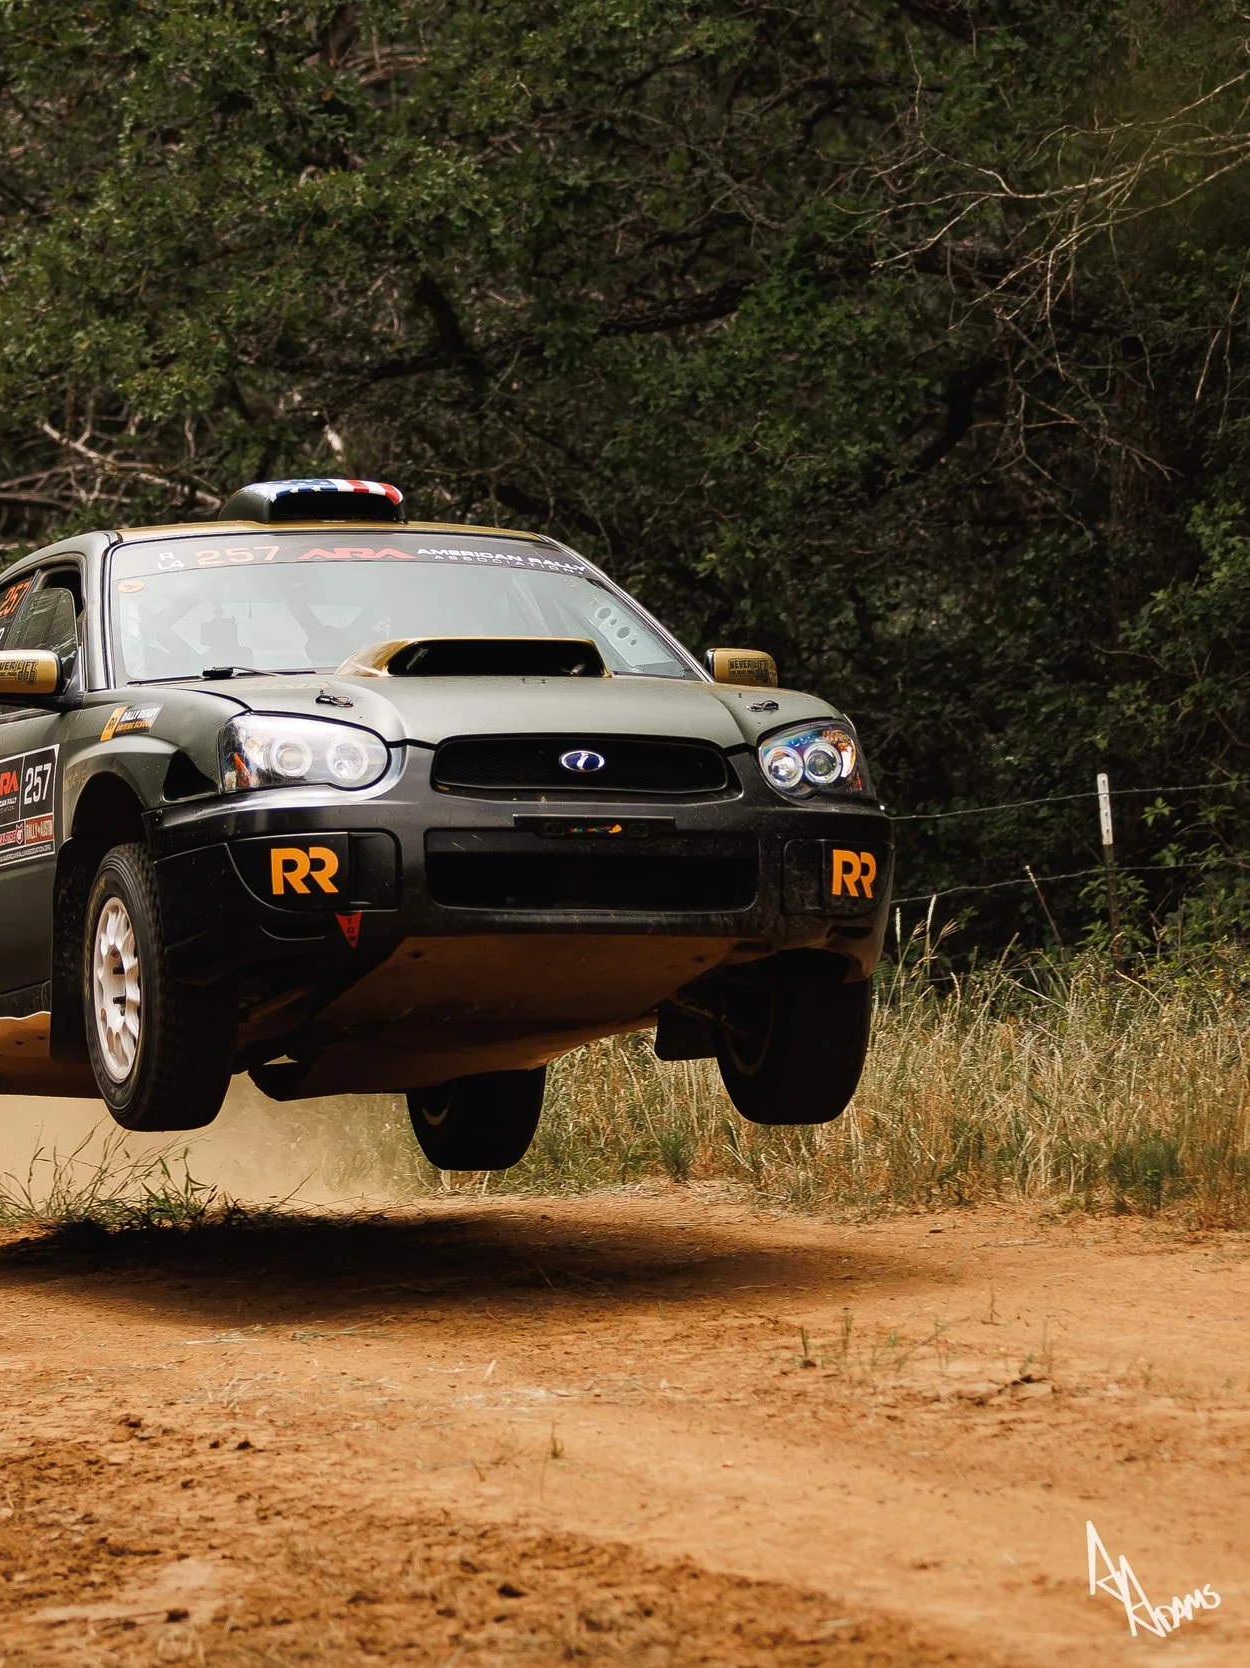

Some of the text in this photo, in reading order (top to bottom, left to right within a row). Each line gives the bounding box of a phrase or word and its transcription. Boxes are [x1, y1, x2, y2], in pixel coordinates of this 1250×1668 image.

[158, 552, 175, 561] R
[195, 545, 280, 566] 257
[297, 547, 417, 560] ARA
[417, 548, 587, 572] AMERICAN RALLY
[16, 660, 38, 685] LIFT
[24, 763, 52, 805] 257
[270, 846, 340, 895] RR
[832, 849, 877, 899] RR
